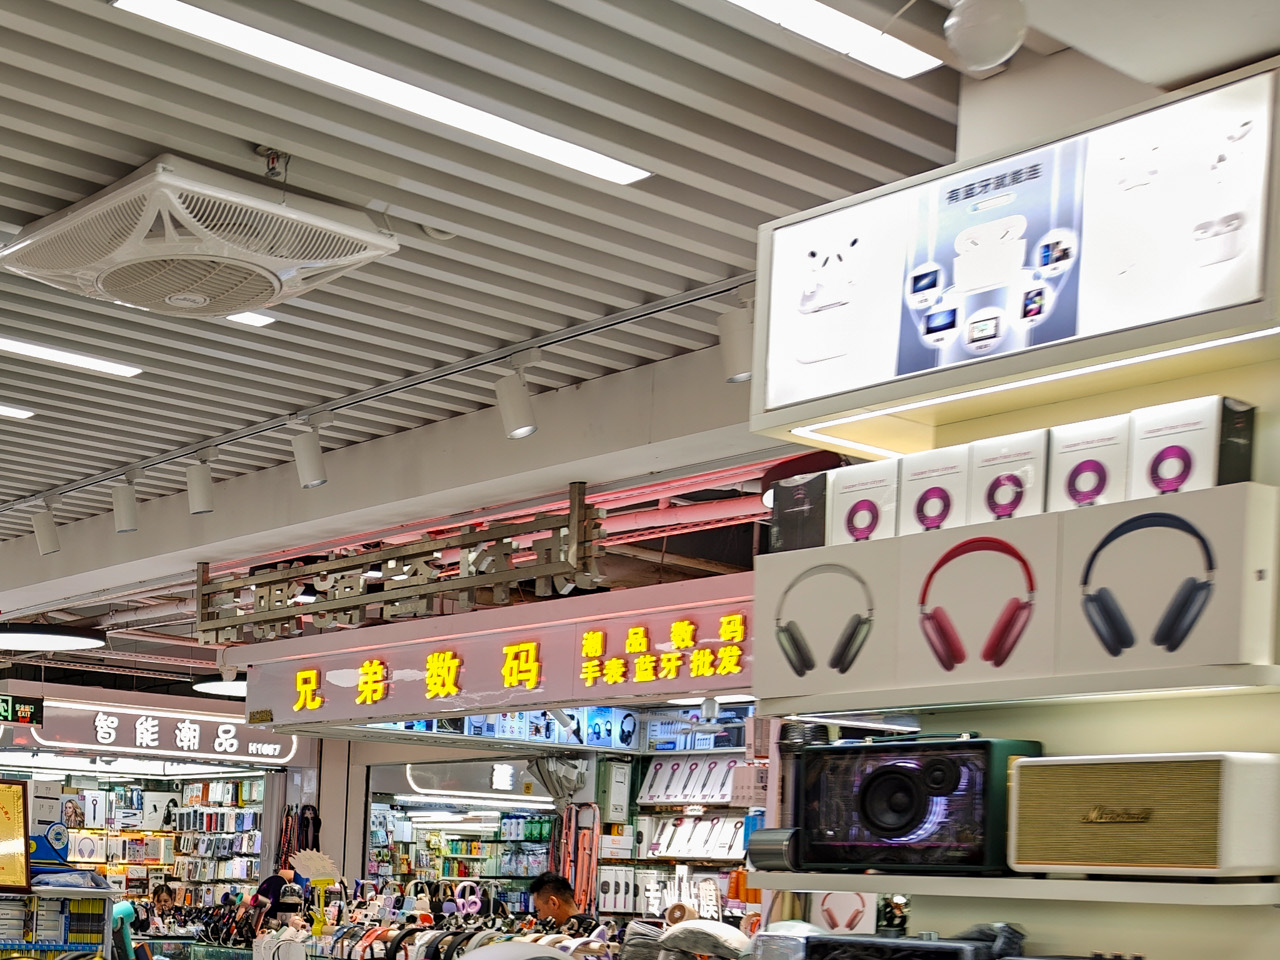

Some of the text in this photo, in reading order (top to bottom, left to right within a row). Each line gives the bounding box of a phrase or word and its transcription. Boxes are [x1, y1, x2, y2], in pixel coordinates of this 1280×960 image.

[582, 614, 745, 659] 潮品数码
[292, 641, 543, 713] 兄弟数码
[579, 646, 743, 687] 手表蓝牙批发
[94, 711, 240, 753] 智能潮品
